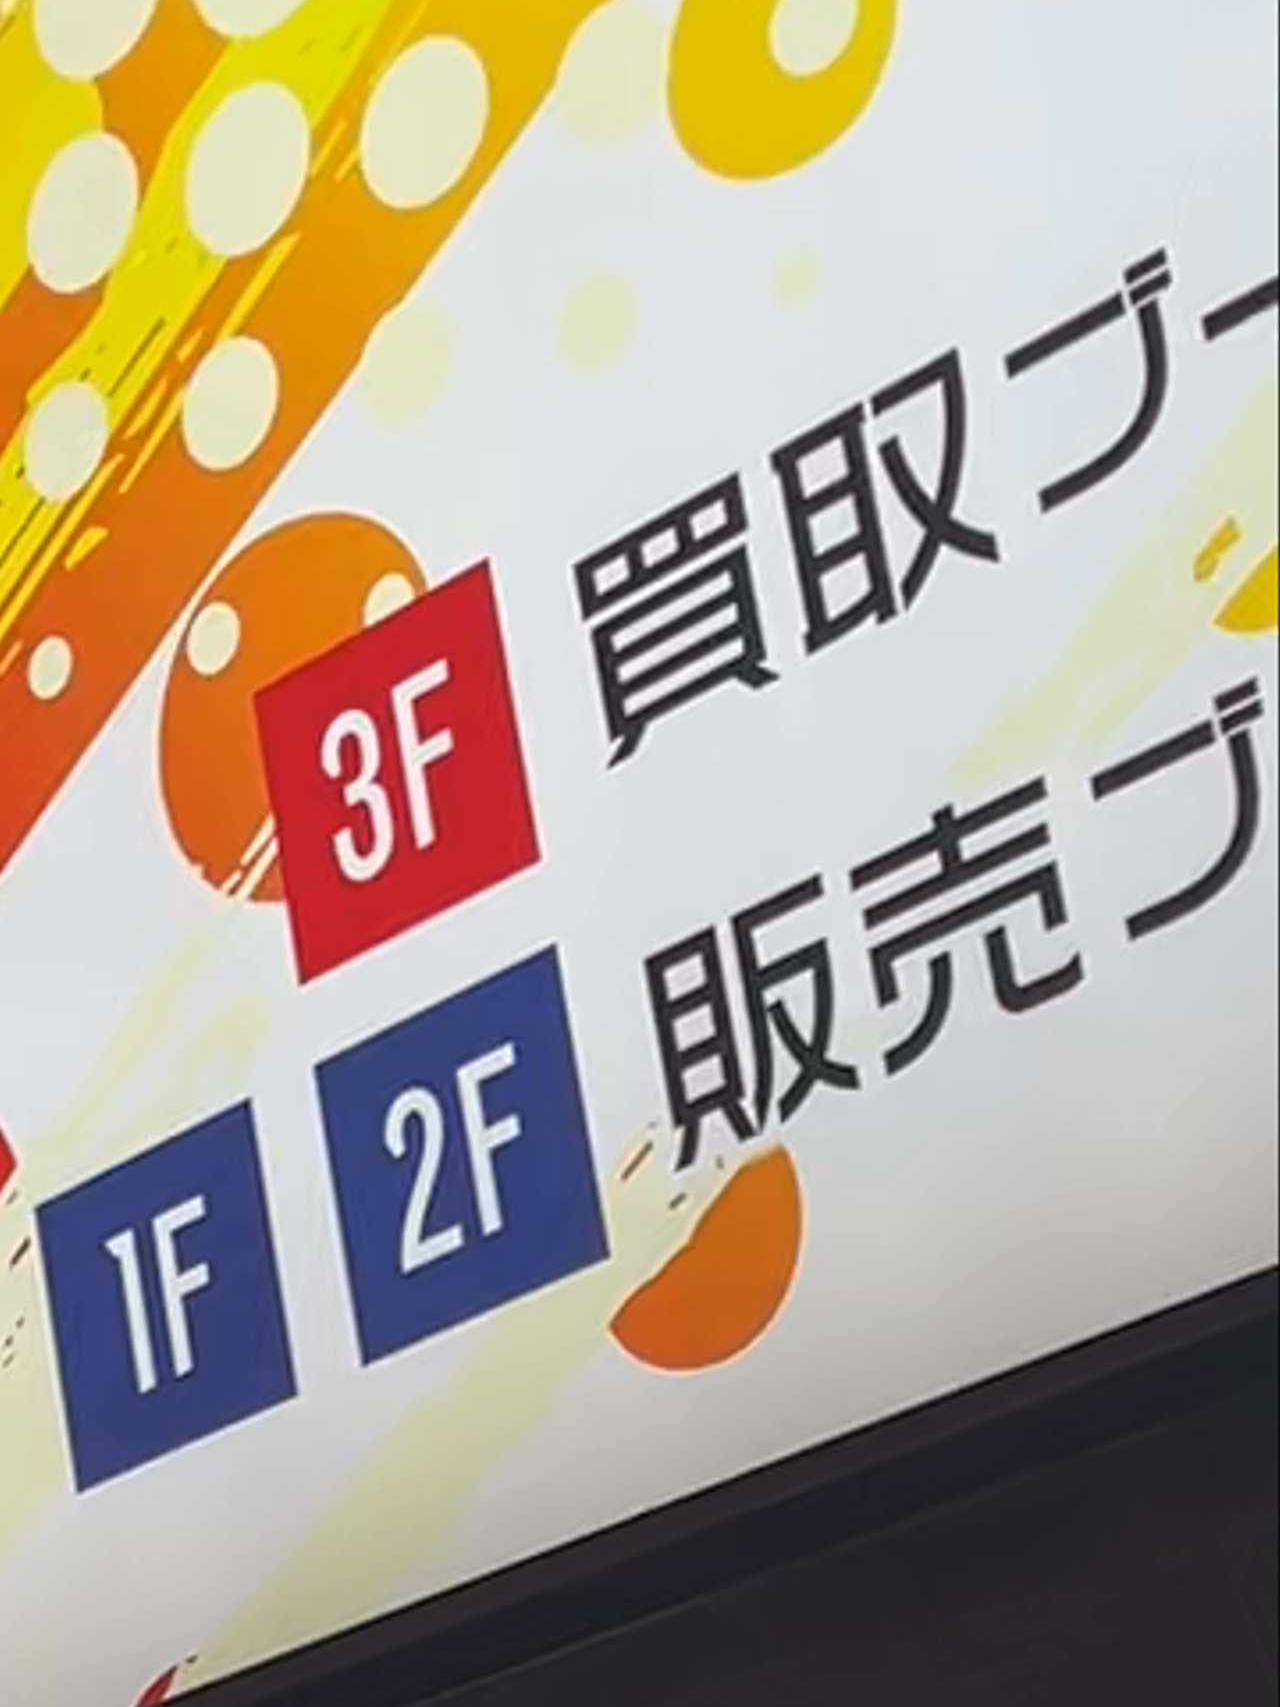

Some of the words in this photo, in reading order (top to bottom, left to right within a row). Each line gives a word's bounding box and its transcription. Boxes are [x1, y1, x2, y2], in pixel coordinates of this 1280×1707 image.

[321, 659, 454, 883] 3F
[104, 1194, 211, 1395] 1F
[384, 1043, 523, 1274] 2F
[645, 677, 1264, 1171] 販売ブ
